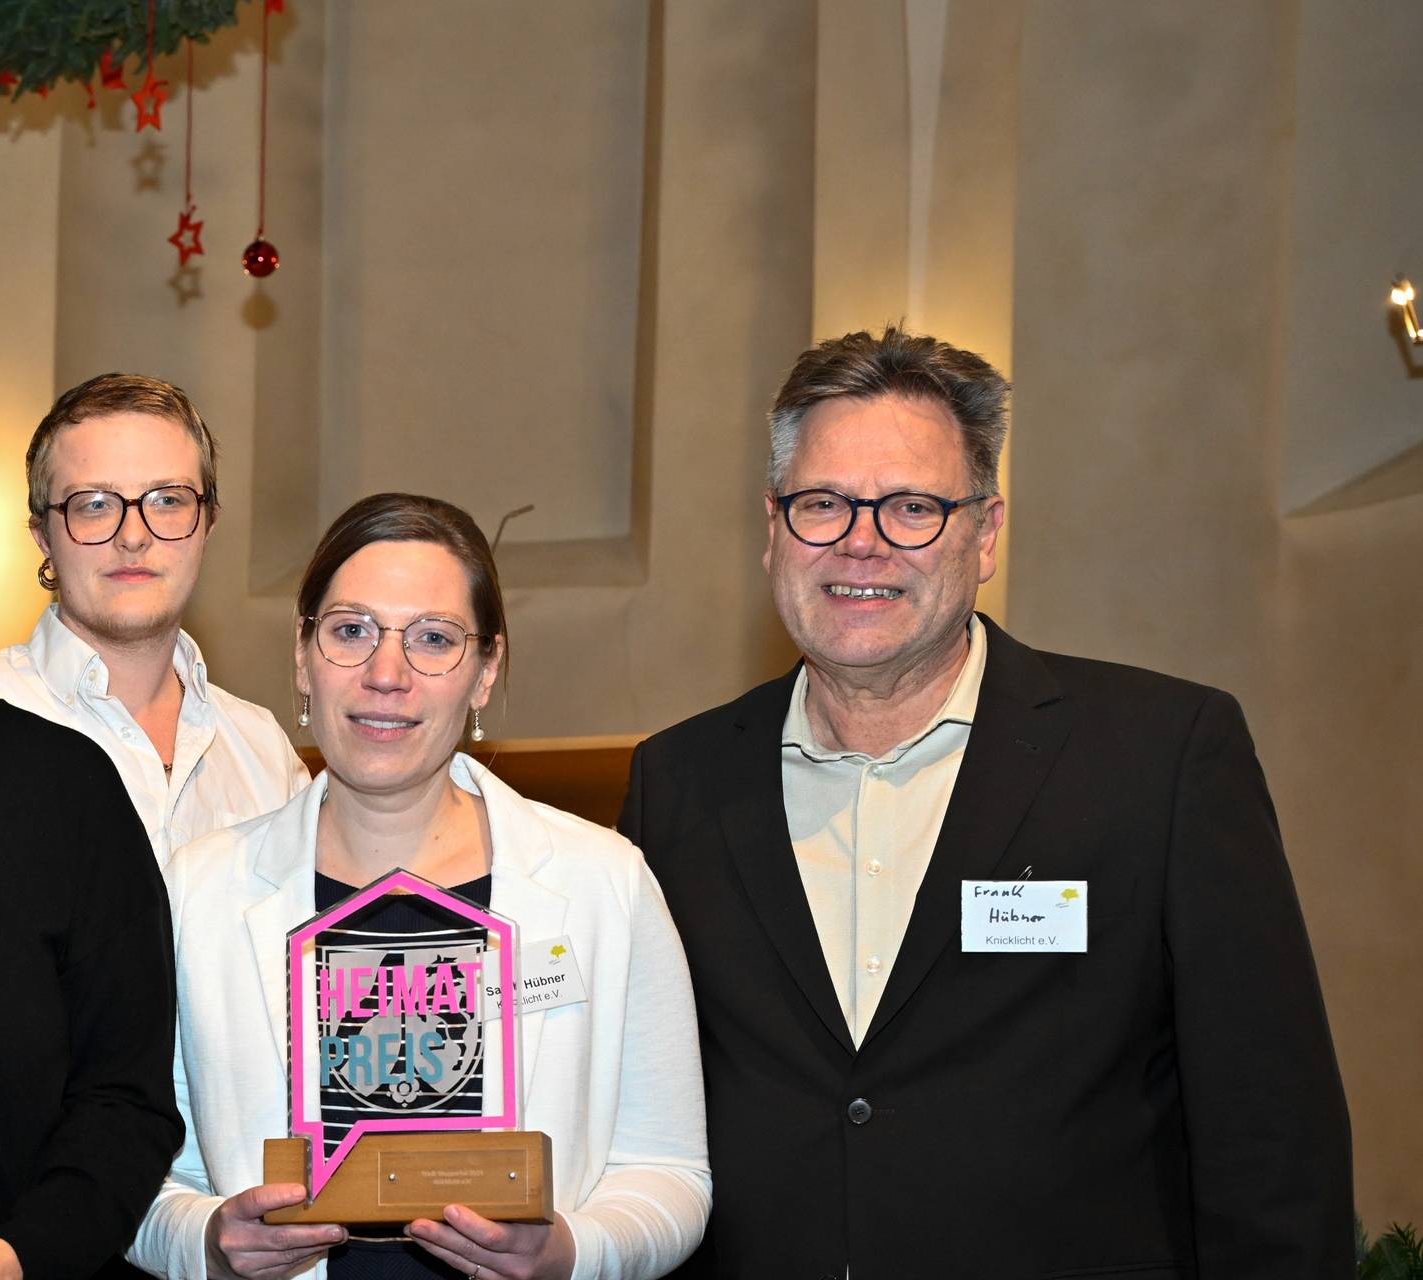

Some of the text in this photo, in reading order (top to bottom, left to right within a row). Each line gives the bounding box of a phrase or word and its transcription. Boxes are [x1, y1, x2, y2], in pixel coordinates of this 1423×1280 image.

[989, 907, 1046, 923] Hübner
[985, 935, 1059, 945] Knicklicht e.V.
[524, 974, 565, 990] Hübner
[320, 962, 482, 1020] HEIMAT
[544, 989, 563, 1000] e.V.
[320, 1031, 445, 1086] PREIS
